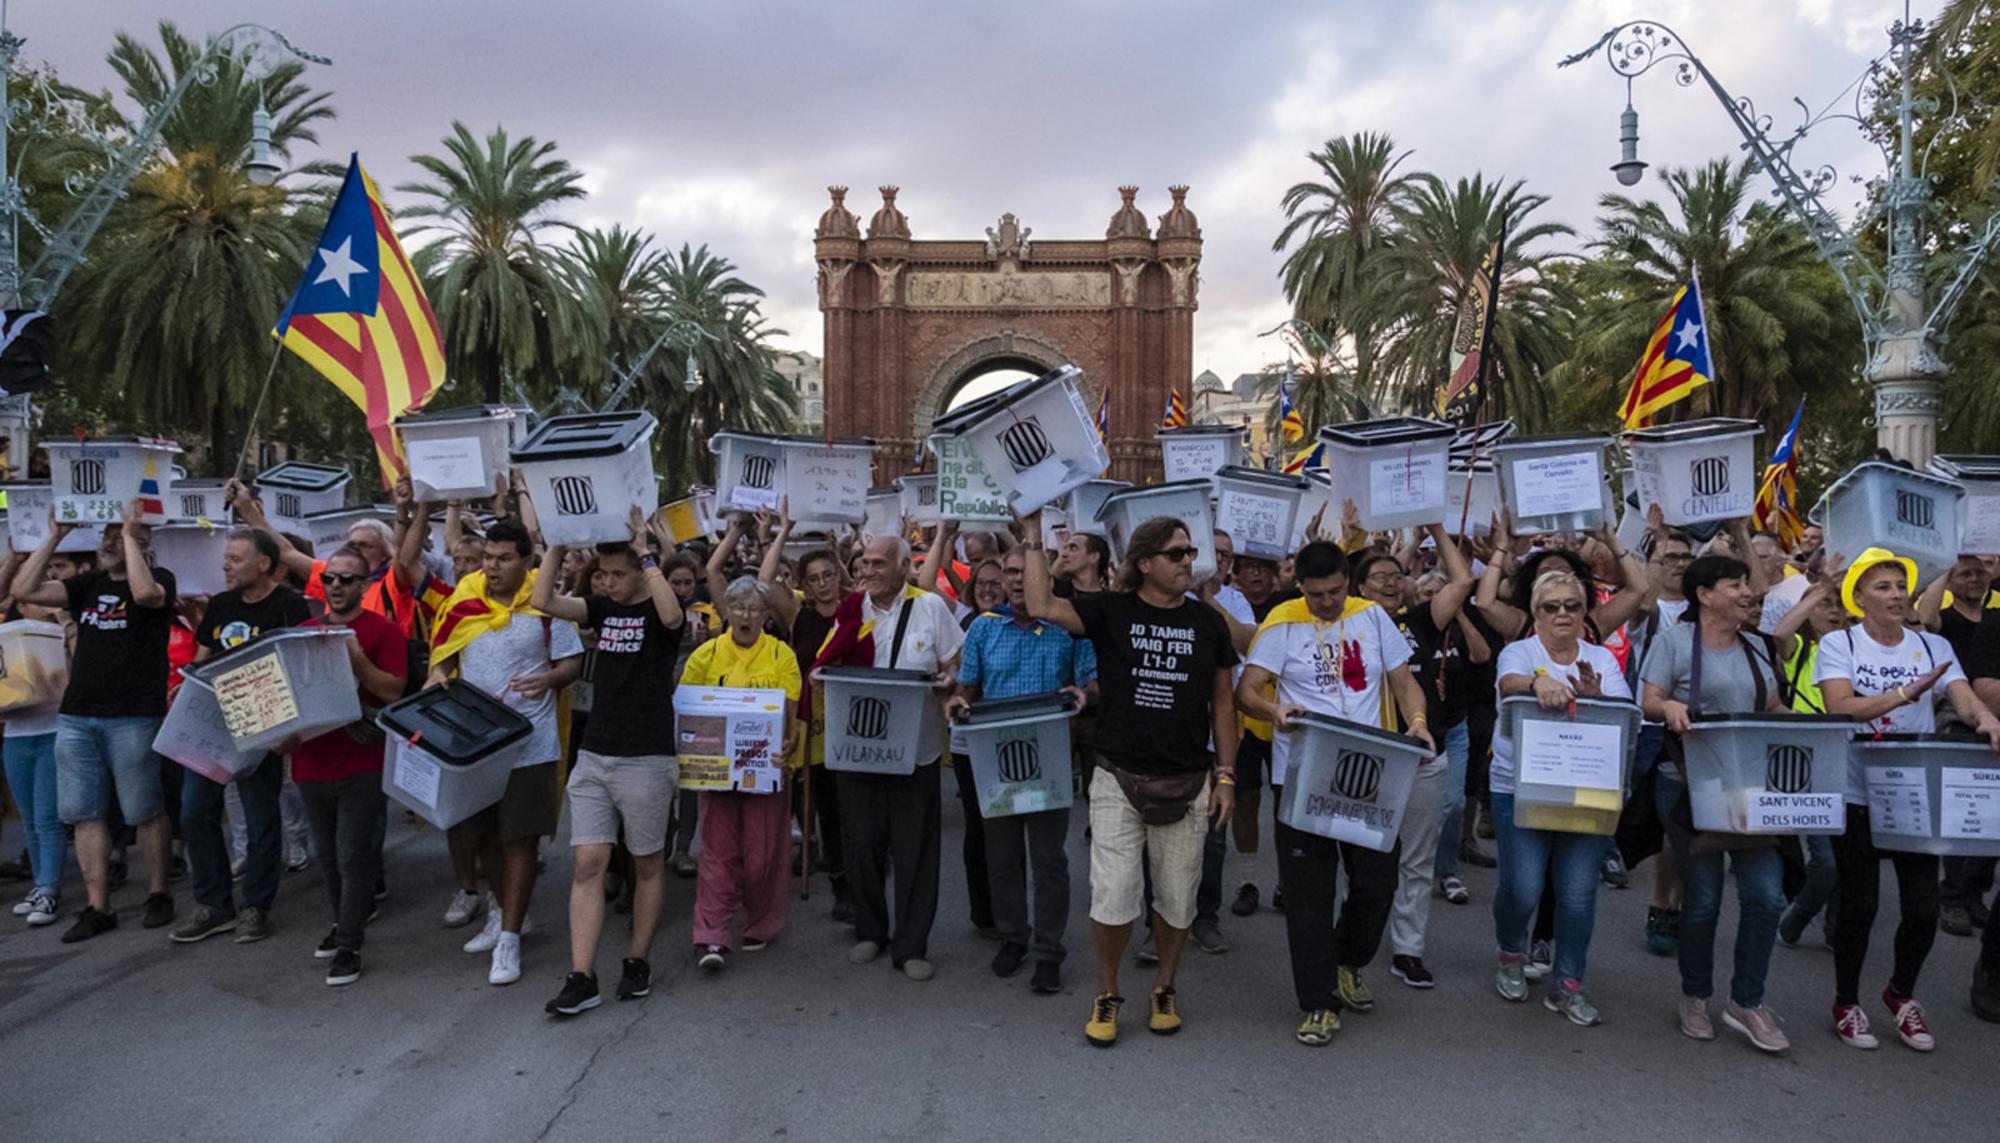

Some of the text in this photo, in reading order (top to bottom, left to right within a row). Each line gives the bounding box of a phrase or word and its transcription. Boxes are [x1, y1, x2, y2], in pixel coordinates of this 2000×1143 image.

[1682, 494, 1751, 516] CENTELLES
[1130, 623, 1196, 641] JO TAMBÉ
[1131, 637, 1193, 655] VAIG FER
[831, 745, 905, 763] VILADRAU
[1759, 797, 1832, 809] SANT VICENÇ
[1762, 815, 1831, 826] DELS HORTS
